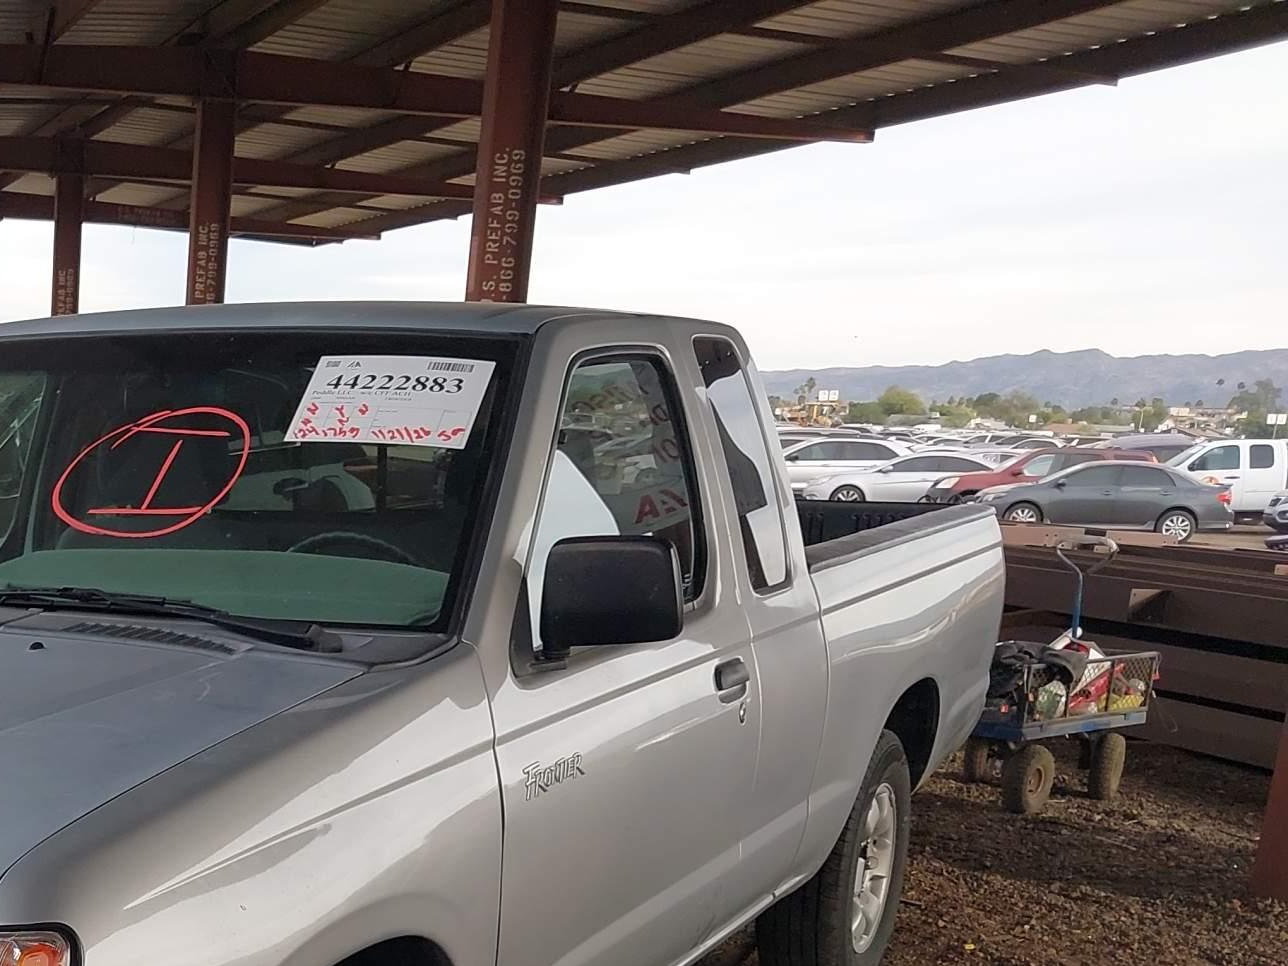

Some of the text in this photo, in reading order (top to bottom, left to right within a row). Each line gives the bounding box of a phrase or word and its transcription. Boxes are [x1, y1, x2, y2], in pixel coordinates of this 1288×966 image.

[492, 147, 510, 183] INC.
[484, 192, 506, 265] PREFAB
[194, 251, 208, 299] PREFAB
[326, 374, 464, 394] 44222883
